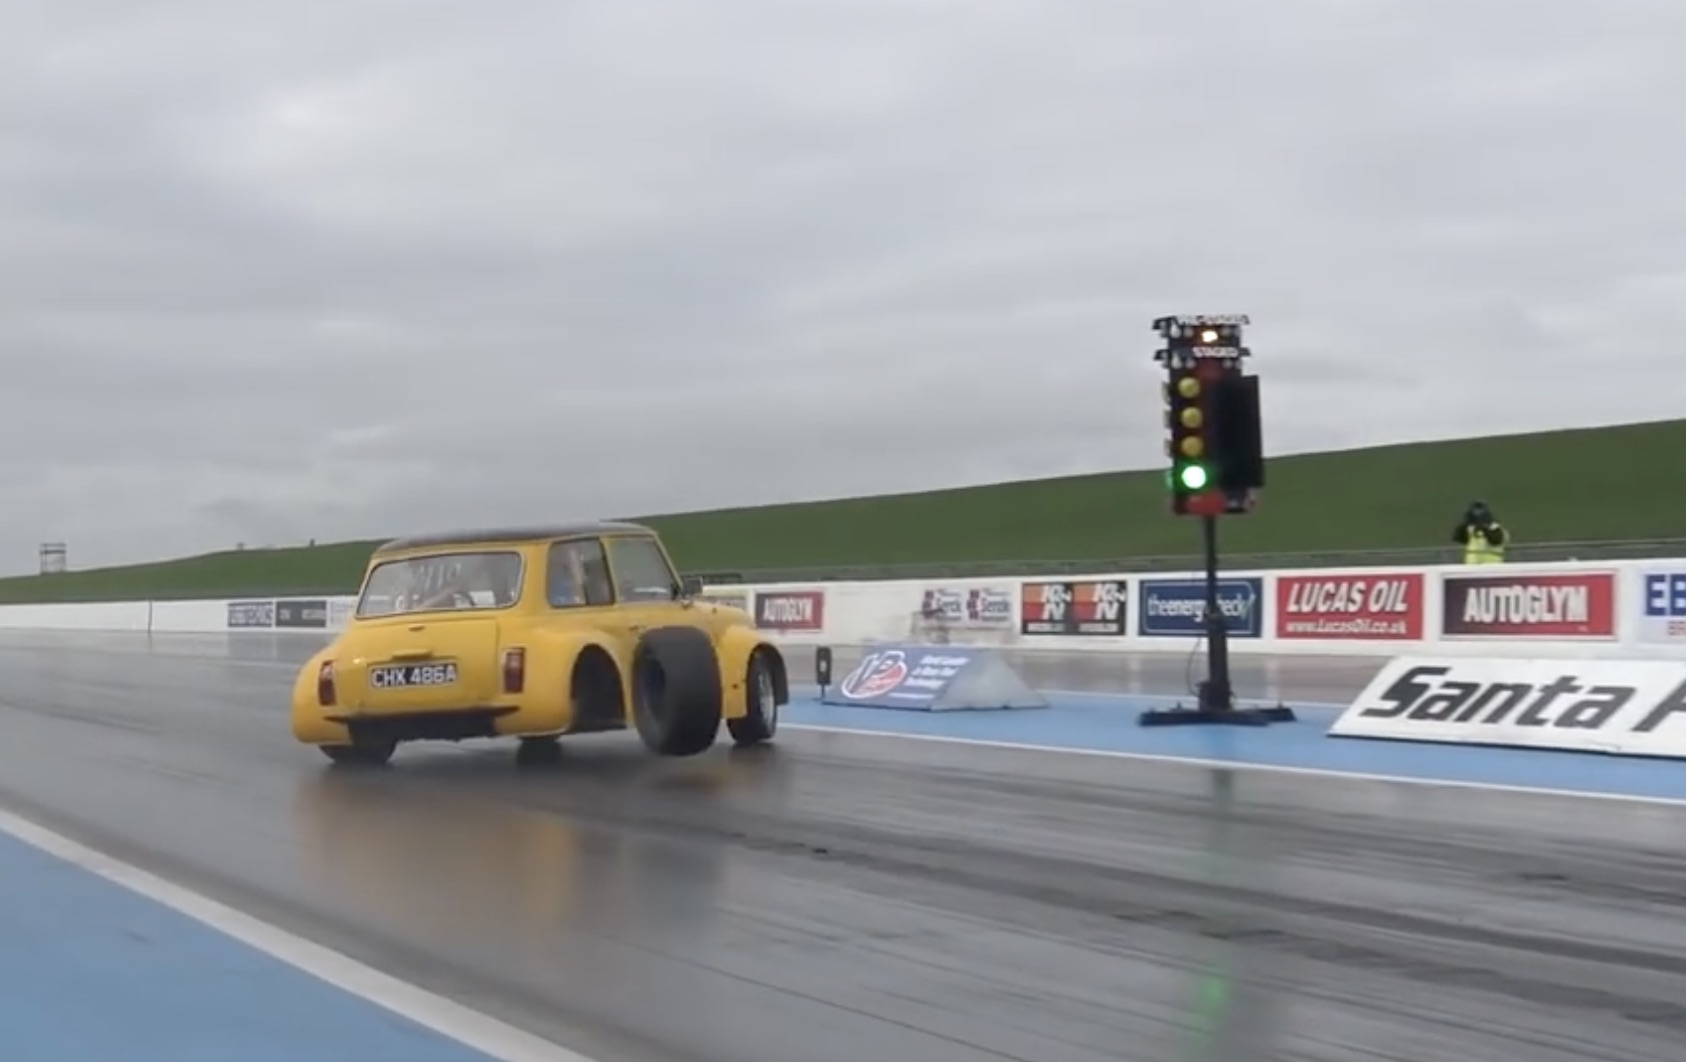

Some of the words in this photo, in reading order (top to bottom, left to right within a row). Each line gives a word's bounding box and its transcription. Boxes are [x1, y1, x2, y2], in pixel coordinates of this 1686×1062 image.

[1286, 581, 1366, 613] LUCAS
[1368, 580, 1408, 613] OIL
[1464, 585, 1589, 624] AUTOGLYM
[408, 664, 457, 685] 486A
[1357, 665, 1637, 730] Santa
